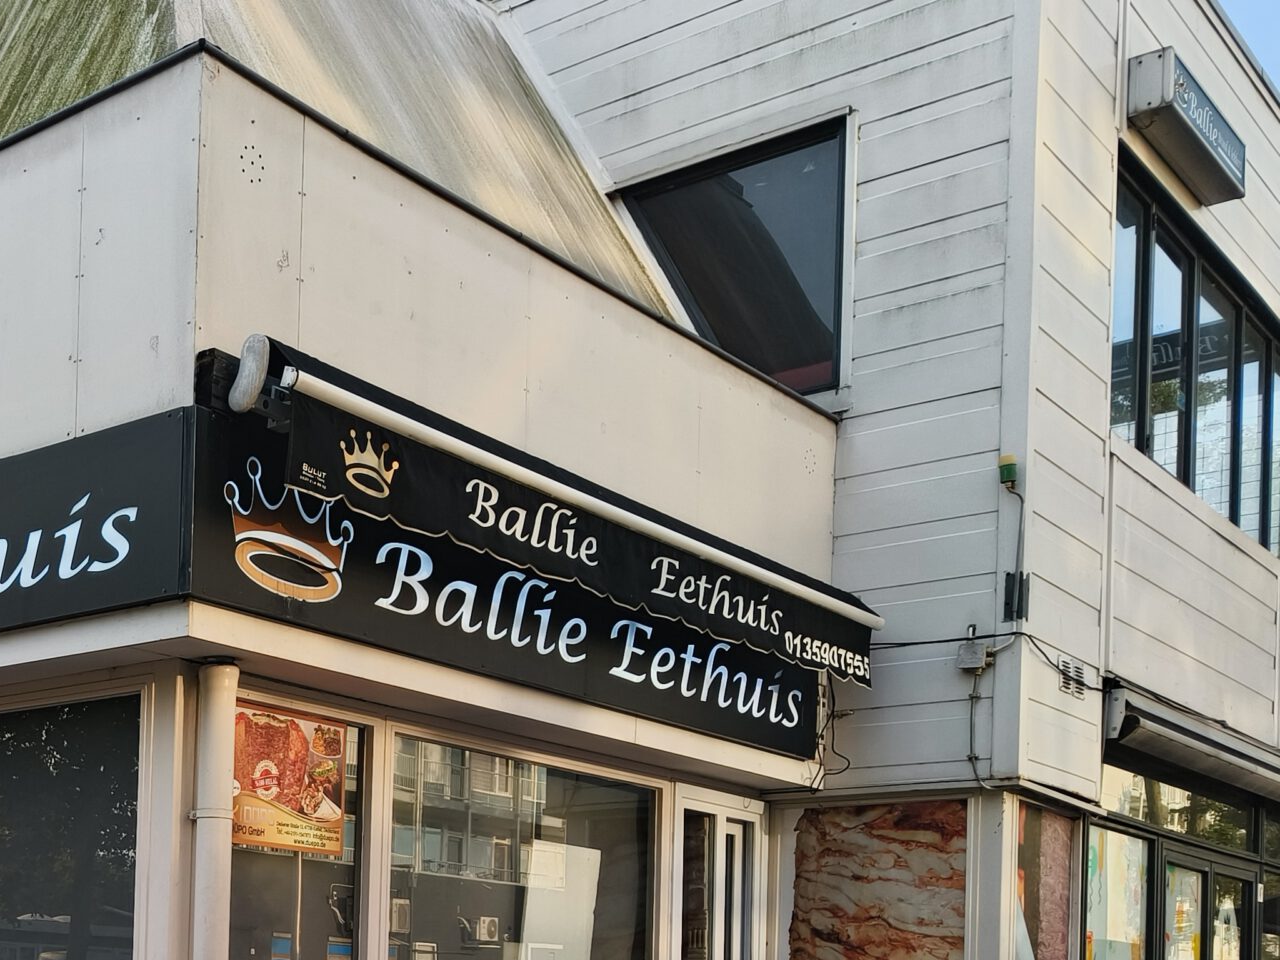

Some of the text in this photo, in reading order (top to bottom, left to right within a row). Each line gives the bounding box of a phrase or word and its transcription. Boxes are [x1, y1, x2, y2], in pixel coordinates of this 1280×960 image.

[1189, 91, 1217, 146] Ballie
[465, 478, 783, 637] Ballie Eethuis
[374, 541, 804, 729] Ballie Eethuis
[784, 631, 870, 680] 0135907555
